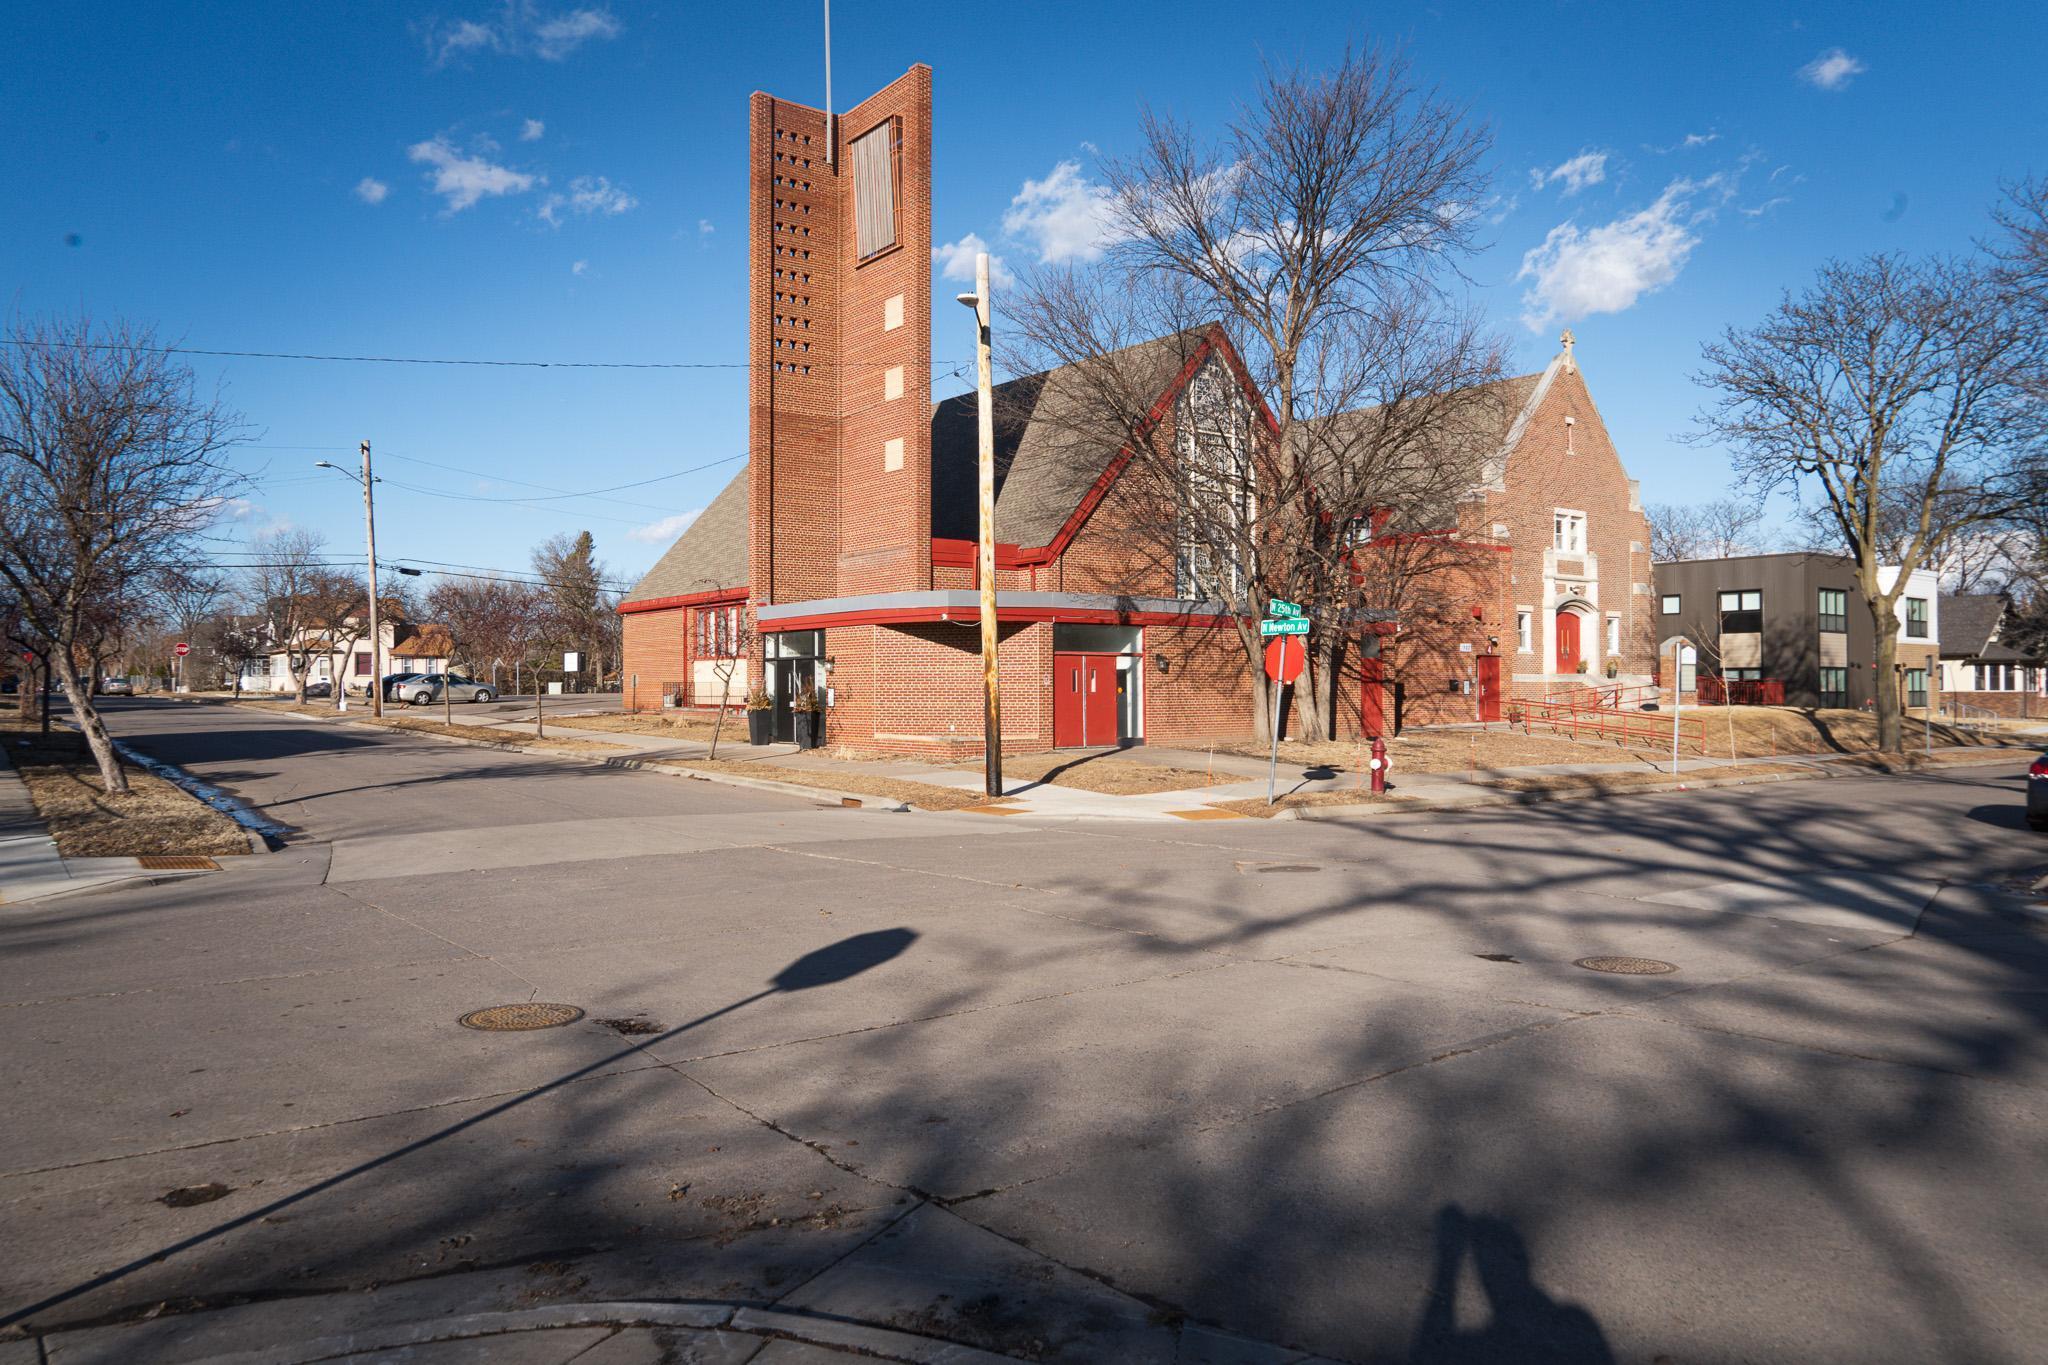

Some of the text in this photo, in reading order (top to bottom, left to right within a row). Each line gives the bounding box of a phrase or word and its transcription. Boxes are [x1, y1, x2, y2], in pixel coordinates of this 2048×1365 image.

[1278, 603, 1290, 615] 25th
[1292, 606, 1299, 617] Av
[1262, 621, 1308, 632] N Newton Av
